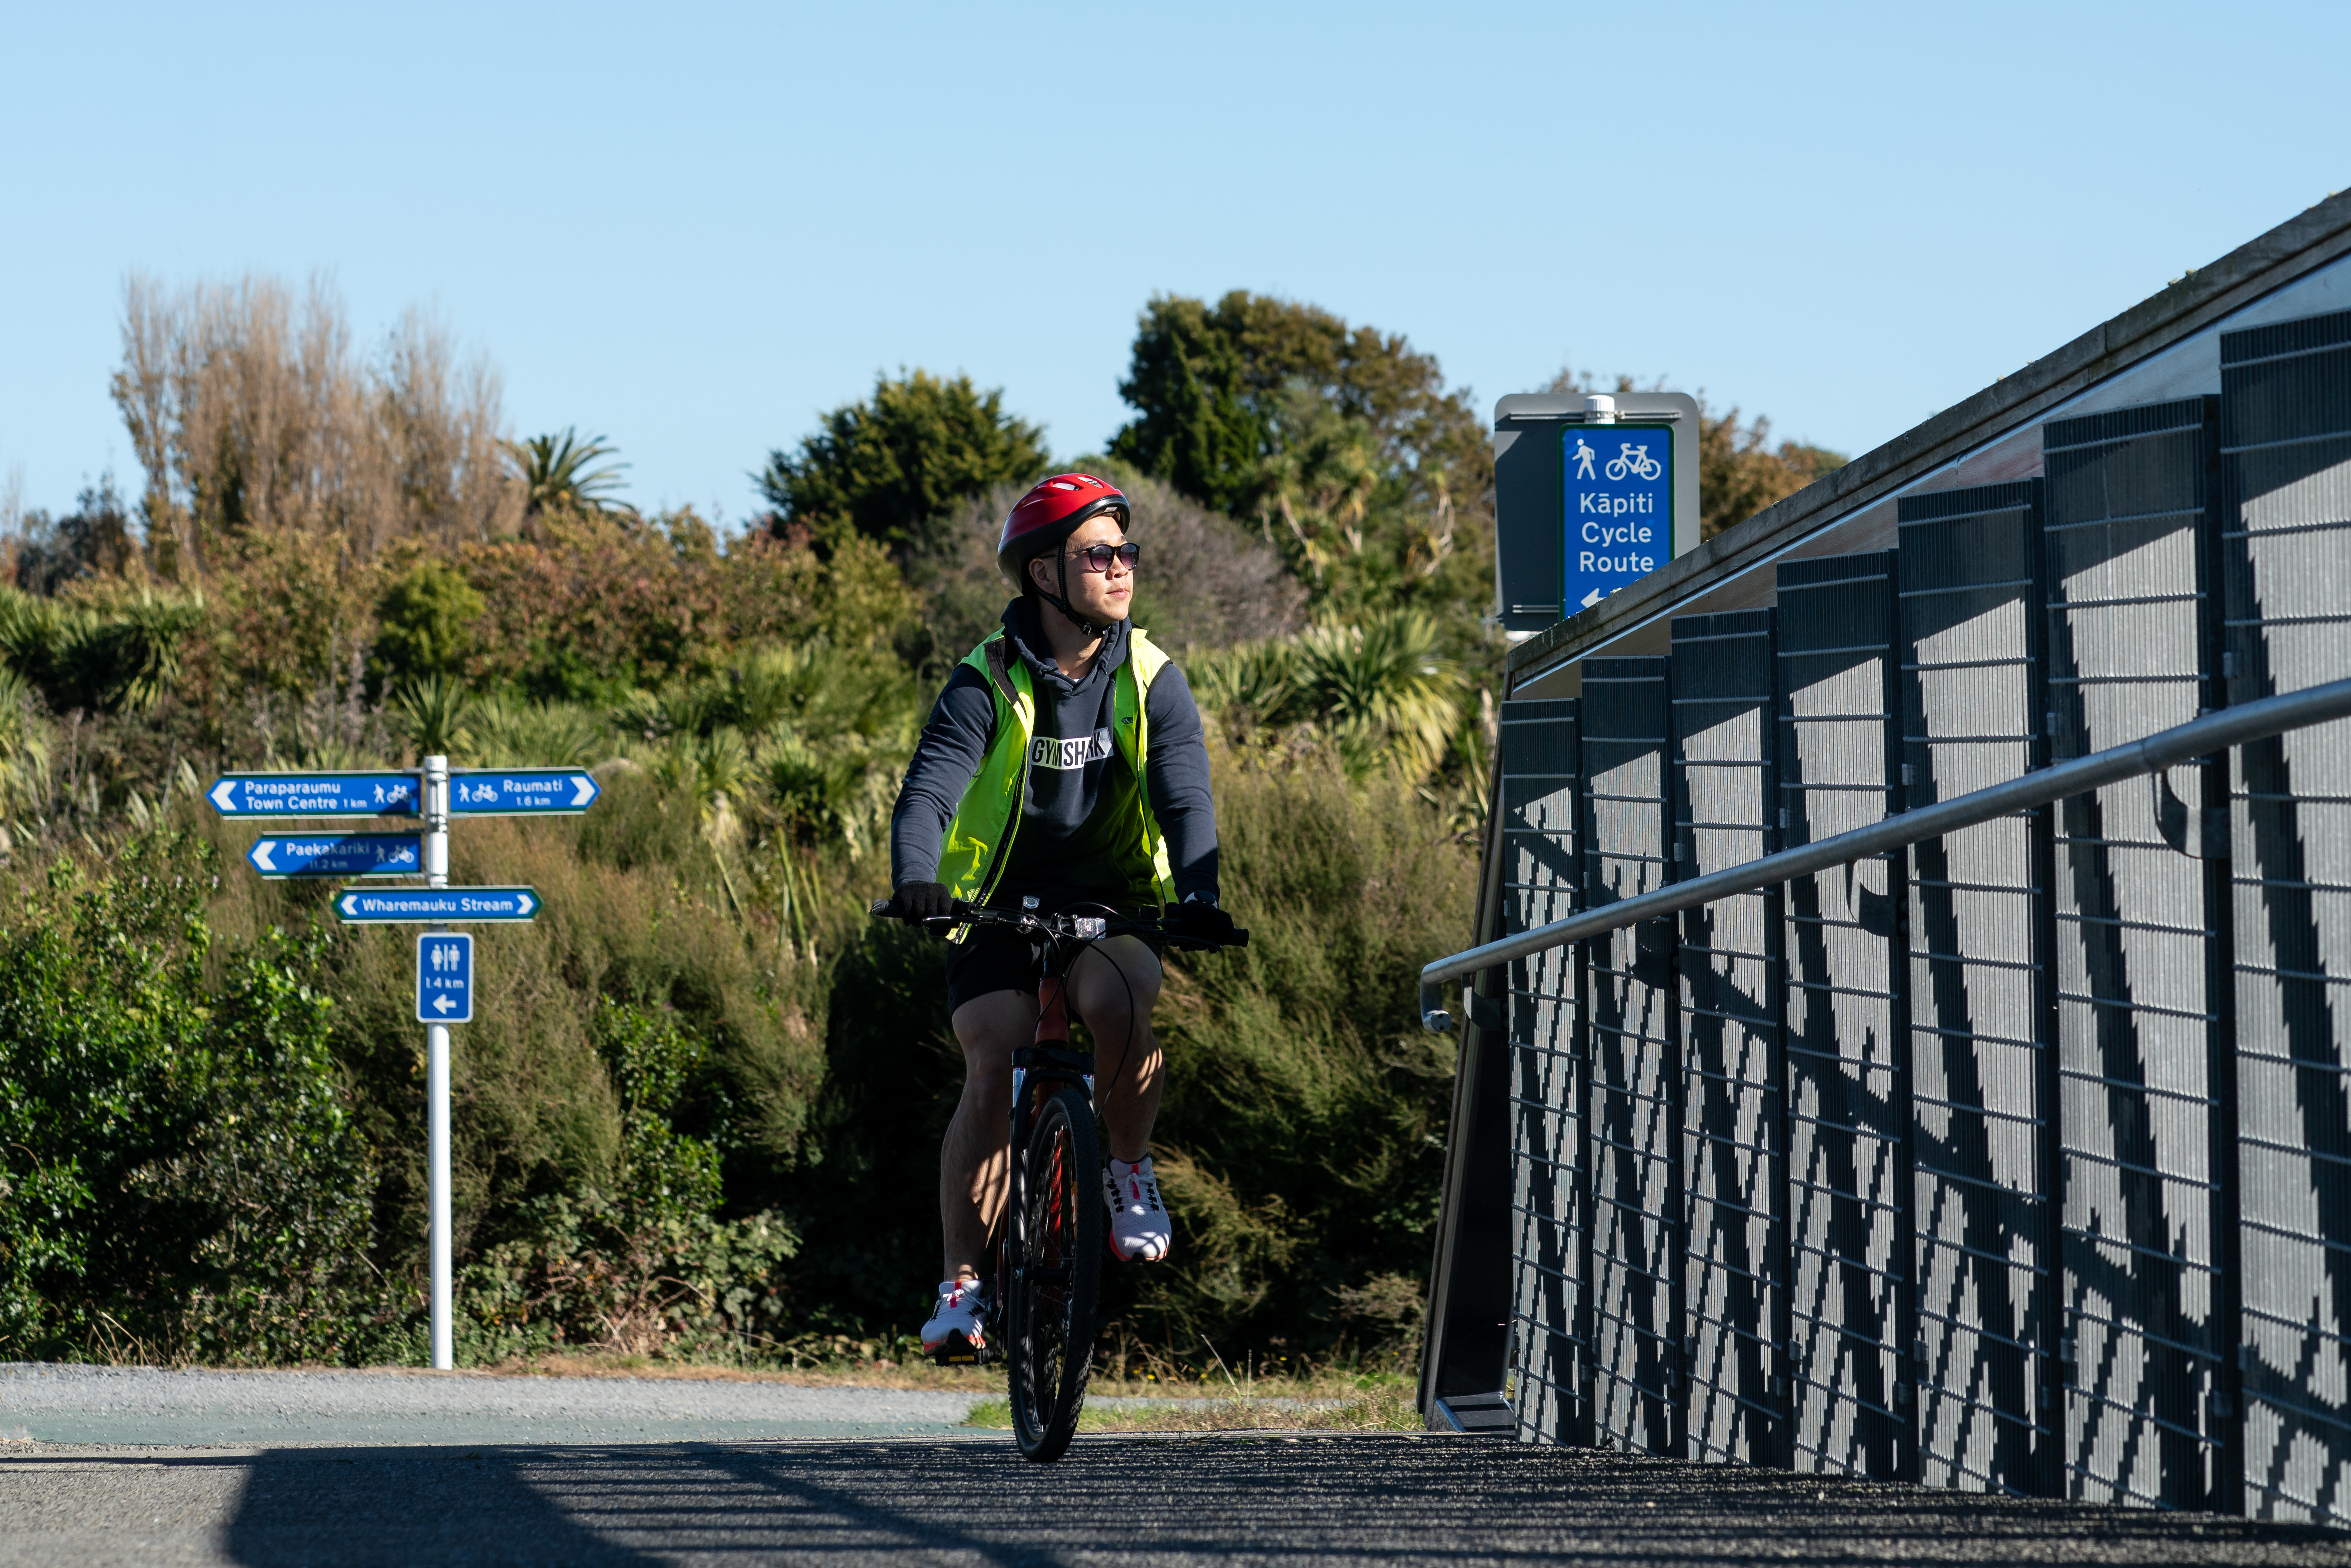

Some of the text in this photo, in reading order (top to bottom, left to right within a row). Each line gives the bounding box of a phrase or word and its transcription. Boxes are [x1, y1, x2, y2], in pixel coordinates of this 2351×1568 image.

[1580, 493, 1653, 517] Kāpiti
[1582, 522, 1652, 547] Cycle
[1580, 551, 1654, 572] Route
[1031, 731, 1106, 767] GYMSHRK
[245, 780, 341, 796] Paraparaumu
[503, 778, 563, 792] Raumati
[246, 796, 367, 810] Town Centre 1 km
[516, 796, 551, 807] 1.6 km
[286, 842, 370, 856] Paekakariki
[309, 859, 348, 870] 11.2 km
[362, 897, 513, 912] Wharemauku Stream
[426, 976, 465, 989] 1.4 km
